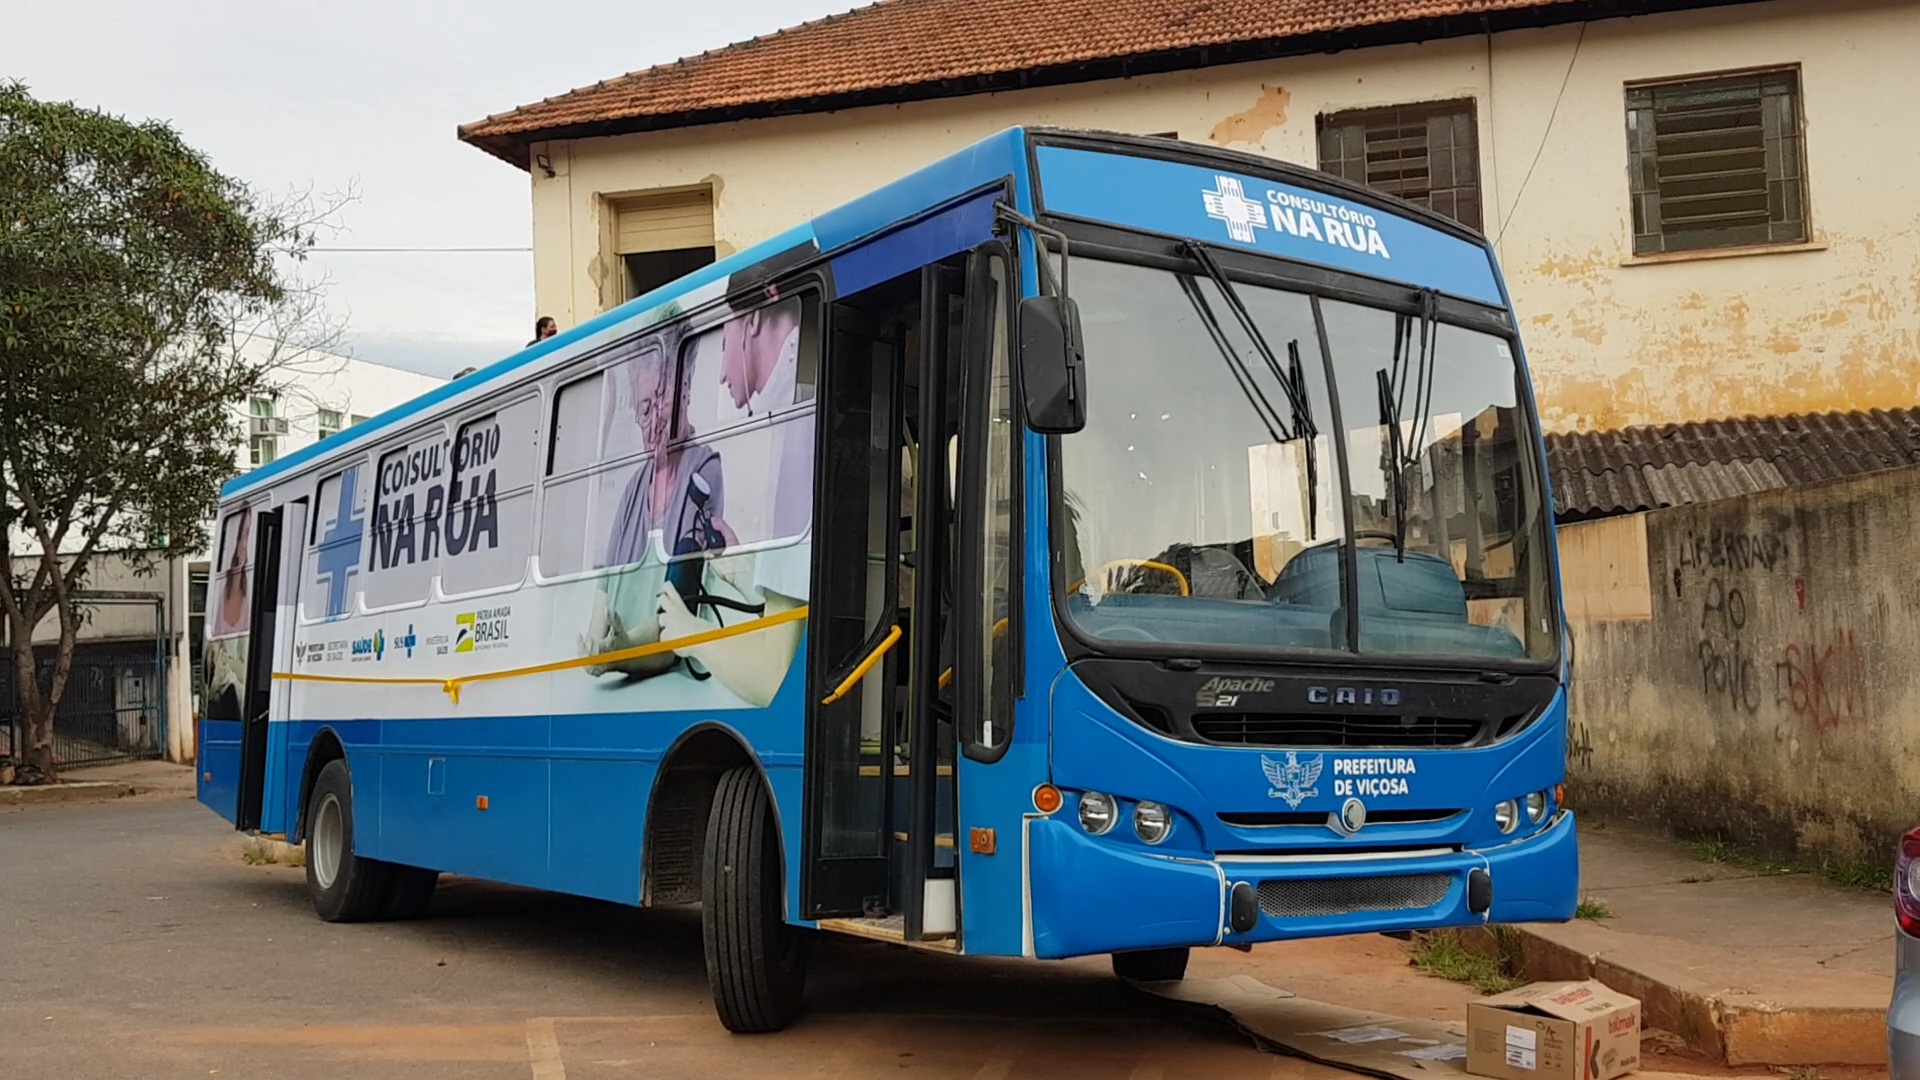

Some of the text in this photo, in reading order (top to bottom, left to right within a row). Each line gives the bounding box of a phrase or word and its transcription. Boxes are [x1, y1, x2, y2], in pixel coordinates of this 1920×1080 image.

[1266, 189, 1376, 229] CONSULTÓRIO
[1270, 203, 1391, 260] NA RUA
[368, 468, 498, 572] NA RUA
[474, 619, 509, 643] BRASIL
[1200, 676, 1276, 692] Apache
[1307, 686, 1401, 705] CAIO
[1333, 758, 1416, 776] PREFEITURA
[1334, 778, 1409, 798] DE VIÇOSA
